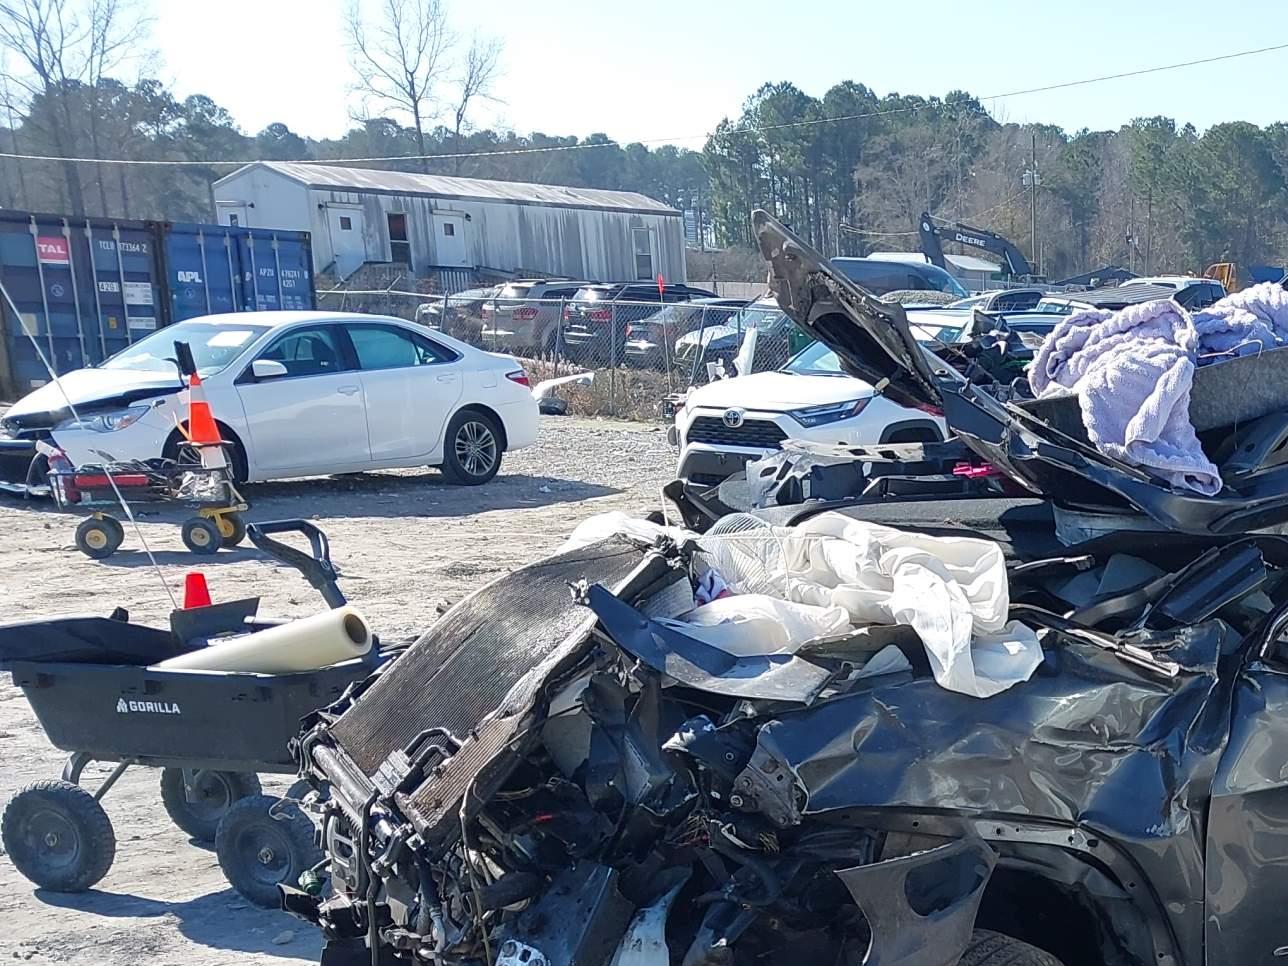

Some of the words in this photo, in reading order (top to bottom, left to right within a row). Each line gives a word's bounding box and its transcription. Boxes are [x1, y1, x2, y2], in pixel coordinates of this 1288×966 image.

[955, 233, 986, 247] DEERE
[39, 243, 67, 254] TAL
[141, 243, 147, 253] 2
[177, 271, 203, 283] APL
[128, 700, 181, 714] GORILLA
